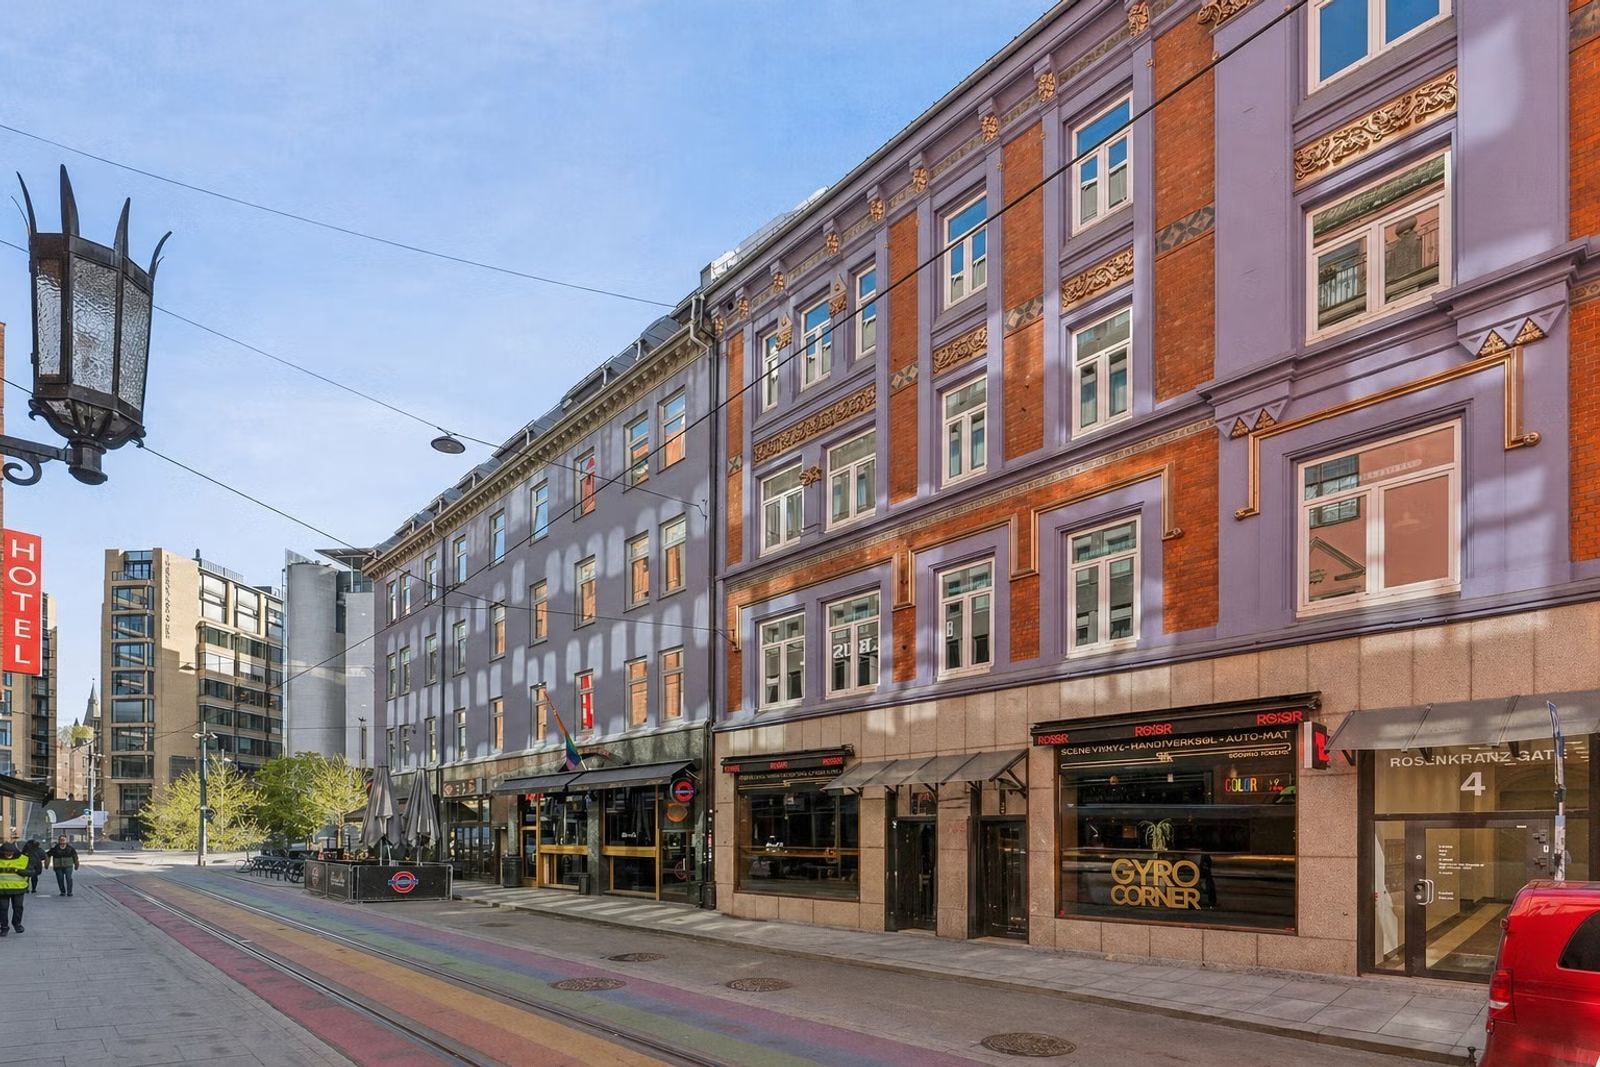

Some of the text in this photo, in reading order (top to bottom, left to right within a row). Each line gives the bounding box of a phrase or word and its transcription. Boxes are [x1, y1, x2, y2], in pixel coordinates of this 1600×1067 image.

[8, 538, 37, 664] HOTEL
[1224, 777, 1257, 792] COLOR
[1460, 771, 1486, 796] 4
[1111, 858, 1200, 888] GYRO
[1110, 884, 1201, 910] CORNER
